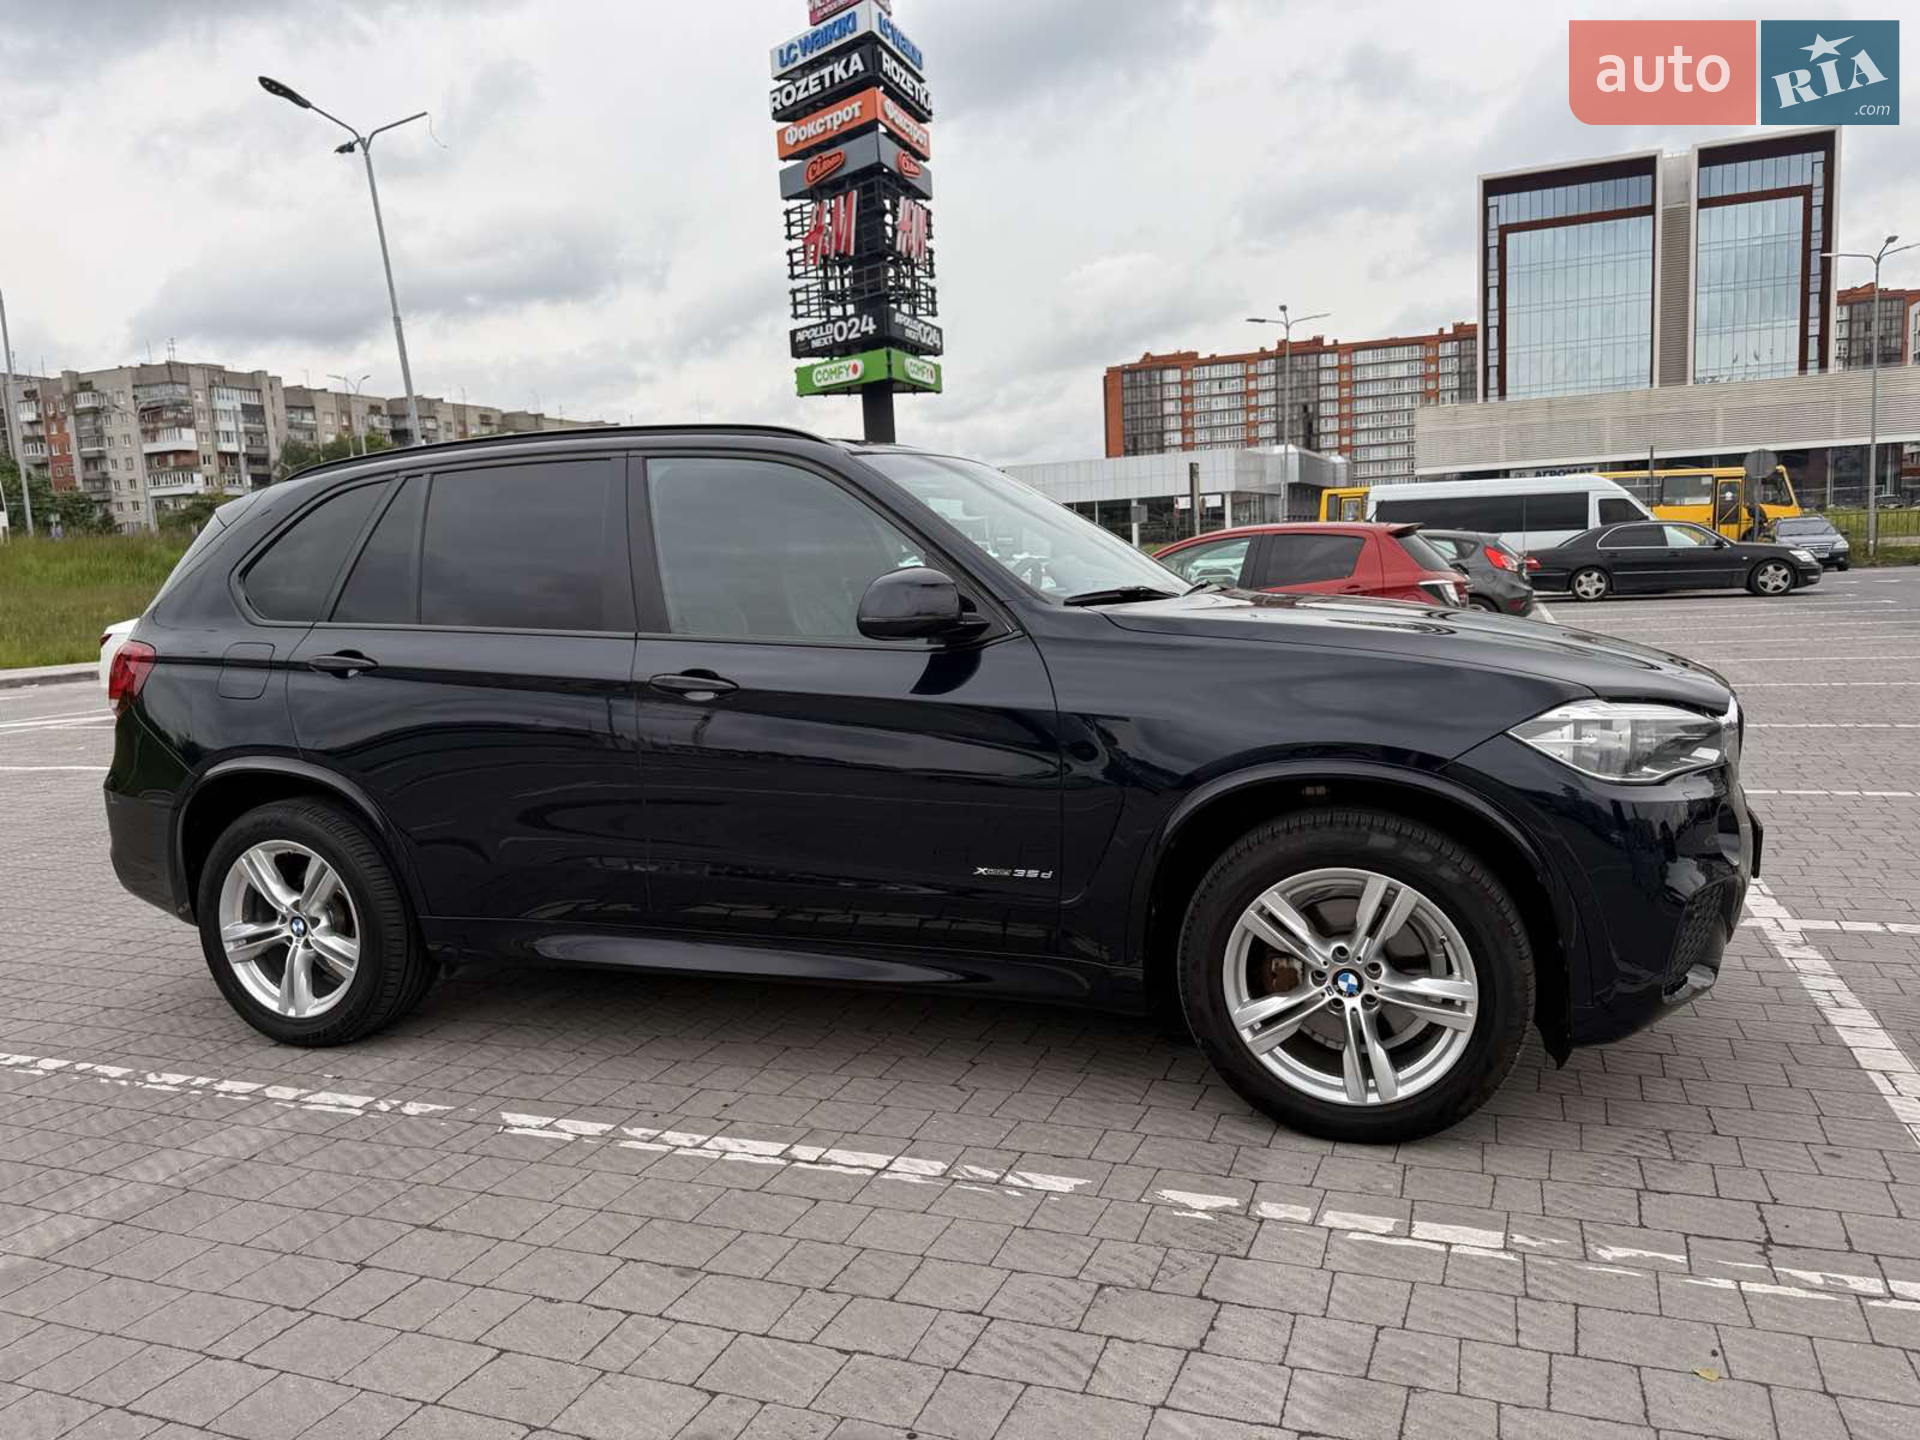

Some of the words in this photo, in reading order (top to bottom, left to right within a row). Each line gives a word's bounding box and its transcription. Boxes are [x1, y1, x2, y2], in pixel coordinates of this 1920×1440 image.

[778, 43, 798, 68] LC
[770, 52, 865, 112] ROZETKA
[785, 101, 863, 146] Фокстрот
[795, 323, 834, 343] APOLLO
[833, 314, 877, 342] 024
[811, 335, 834, 349] NEXT
[815, 363, 850, 383] COMFY
